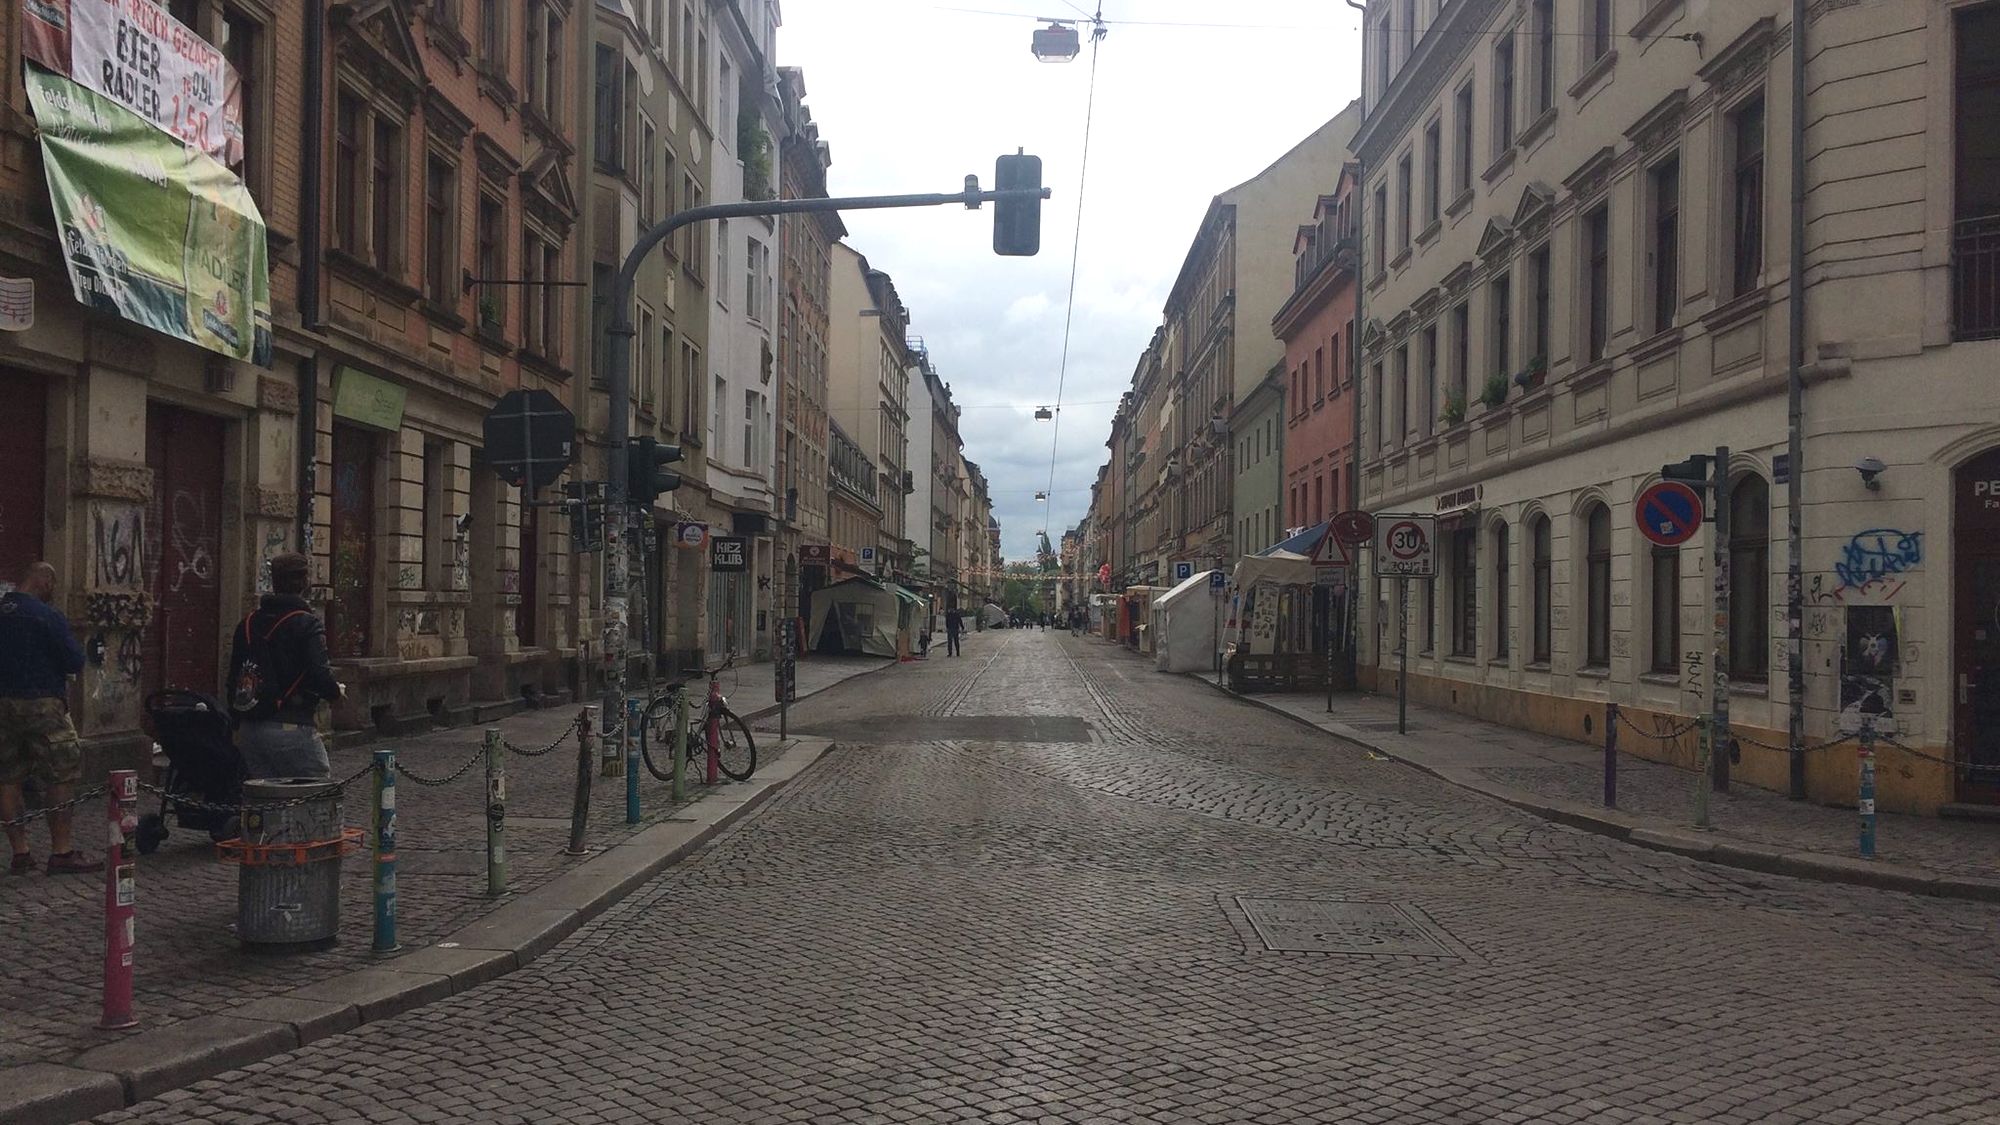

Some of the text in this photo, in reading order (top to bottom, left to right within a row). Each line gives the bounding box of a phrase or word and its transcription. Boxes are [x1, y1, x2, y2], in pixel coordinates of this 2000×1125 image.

[117, 19, 161, 85] BIER
[173, 26, 220, 81] GEZAPFT
[102, 59, 161, 123] RADLER
[1395, 532, 1417, 549] 30
[716, 542, 741, 554] KIEZ
[714, 554, 743, 565] KLUB
[1179, 565, 1187, 576] P
[1213, 574, 1222, 583] P
